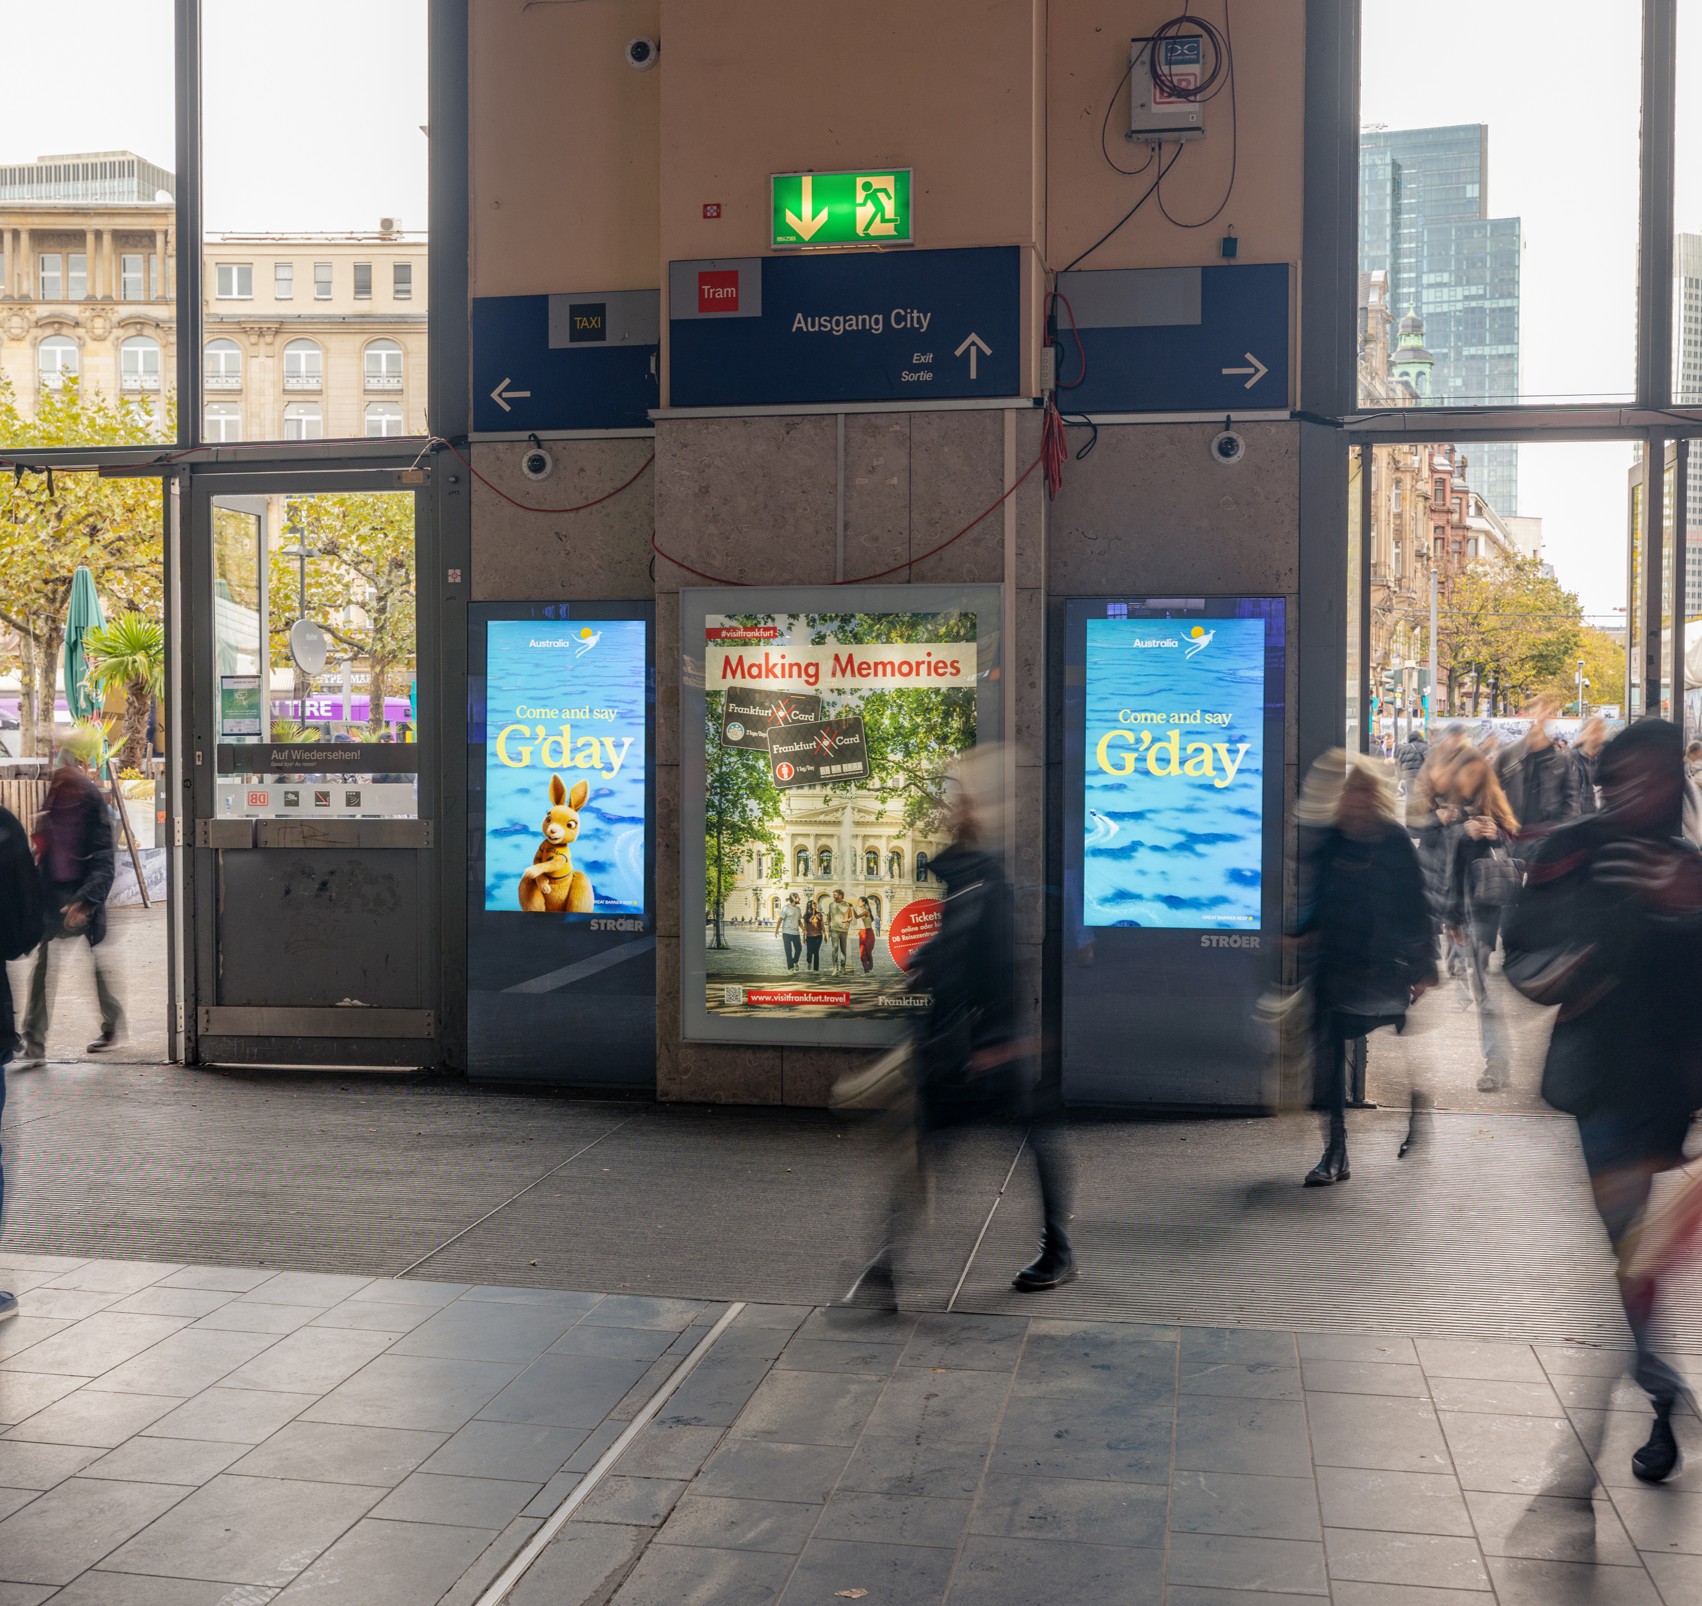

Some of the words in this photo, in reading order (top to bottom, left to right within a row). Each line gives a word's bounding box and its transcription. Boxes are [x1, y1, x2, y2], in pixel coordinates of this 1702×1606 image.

[702, 285, 736, 299] Tram
[574, 317, 601, 329] TAXI
[792, 312, 883, 335] Ausgang
[890, 308, 931, 332] City
[913, 353, 933, 364] Exit
[901, 370, 933, 382] Sortie
[721, 629, 774, 638] #visitfrankfurt
[529, 639, 569, 648] Australia
[1133, 638, 1178, 648] Australia
[721, 652, 820, 686] Making
[831, 651, 961, 678] Memories
[516, 705, 559, 719] Come
[561, 705, 590, 719] and
[593, 708, 618, 722] say
[728, 703, 773, 717] Frankfurt
[791, 710, 815, 721] Card
[1118, 709, 1166, 724] Come
[1169, 709, 1201, 724] and
[1205, 713, 1232, 727] say
[772, 740, 817, 754] Frankfurt
[835, 734, 860, 746] Card
[271, 749, 289, 760] Auf
[291, 749, 361, 760] Wiedersehen!
[496, 723, 635, 780] G'day
[1096, 729, 1251, 788] G'day
[910, 911, 942, 924] Tickets
[590, 918, 644, 932] STRÖER
[901, 925, 919, 934] online
[920, 923, 933, 931] oder
[891, 935, 901, 943] DB
[1200, 935, 1261, 948] STRÖER
[750, 993, 846, 1003] www.visitfrankfurt.travel
[878, 995, 929, 1007] Frankfurt
